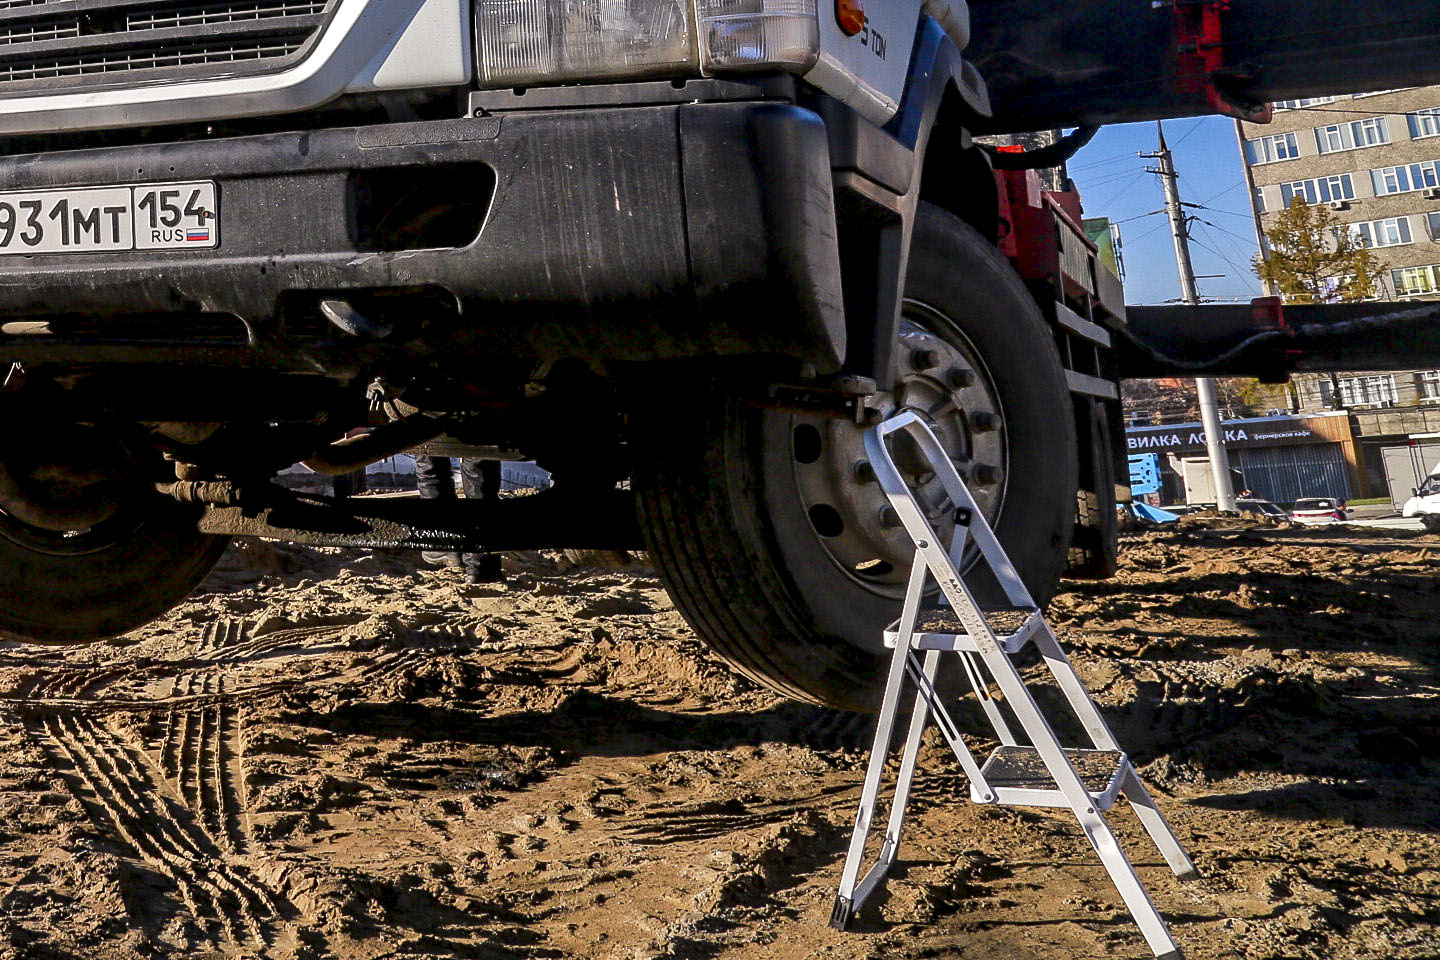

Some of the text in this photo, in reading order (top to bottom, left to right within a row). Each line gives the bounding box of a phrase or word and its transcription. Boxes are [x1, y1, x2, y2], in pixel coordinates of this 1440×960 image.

[871, 29, 887, 61] TON
[138, 189, 206, 229] 154
[151, 228, 184, 243] RUS
[1127, 434, 1182, 449] ВИЛКА
[1188, 429, 1249, 445] ЛОКА
